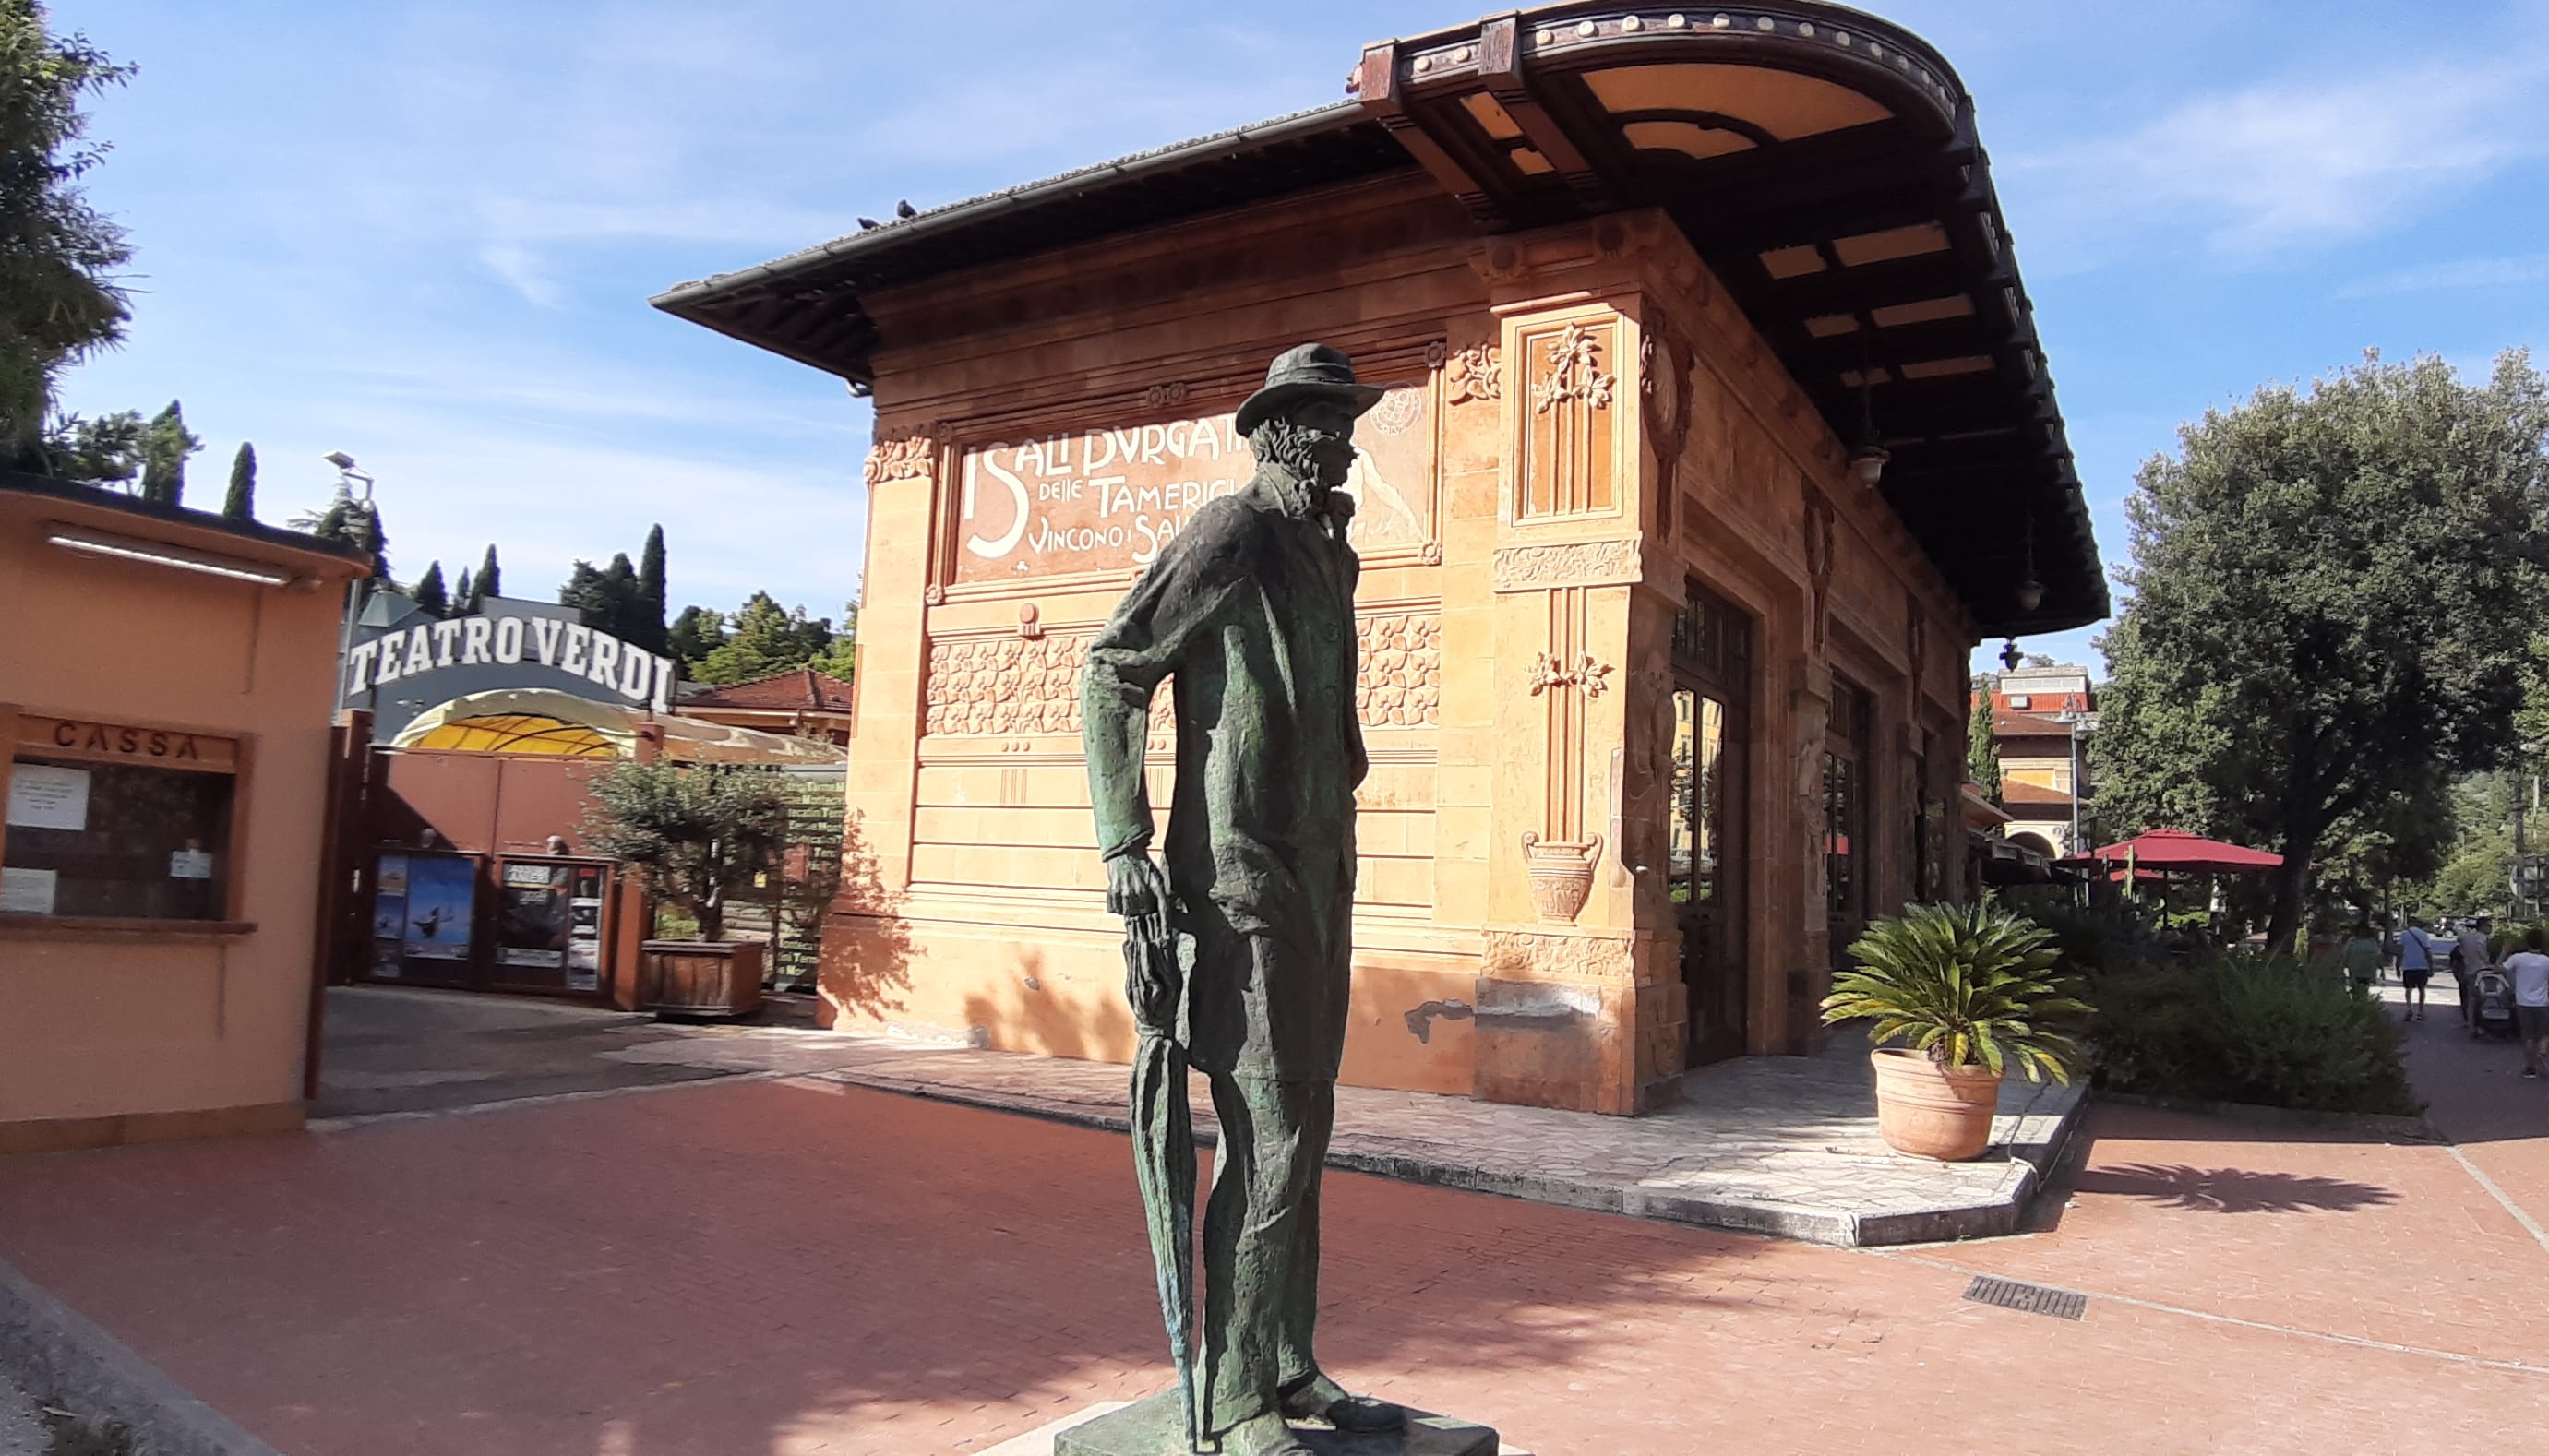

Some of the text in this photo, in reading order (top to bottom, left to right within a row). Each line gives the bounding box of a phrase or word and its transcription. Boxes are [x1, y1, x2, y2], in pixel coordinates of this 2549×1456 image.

[966, 432, 1072, 559] SALI
[1028, 516, 1124, 554] VINCONO
[350, 616, 676, 714] TEATRO VERDI
[54, 722, 198, 760] CASSA
